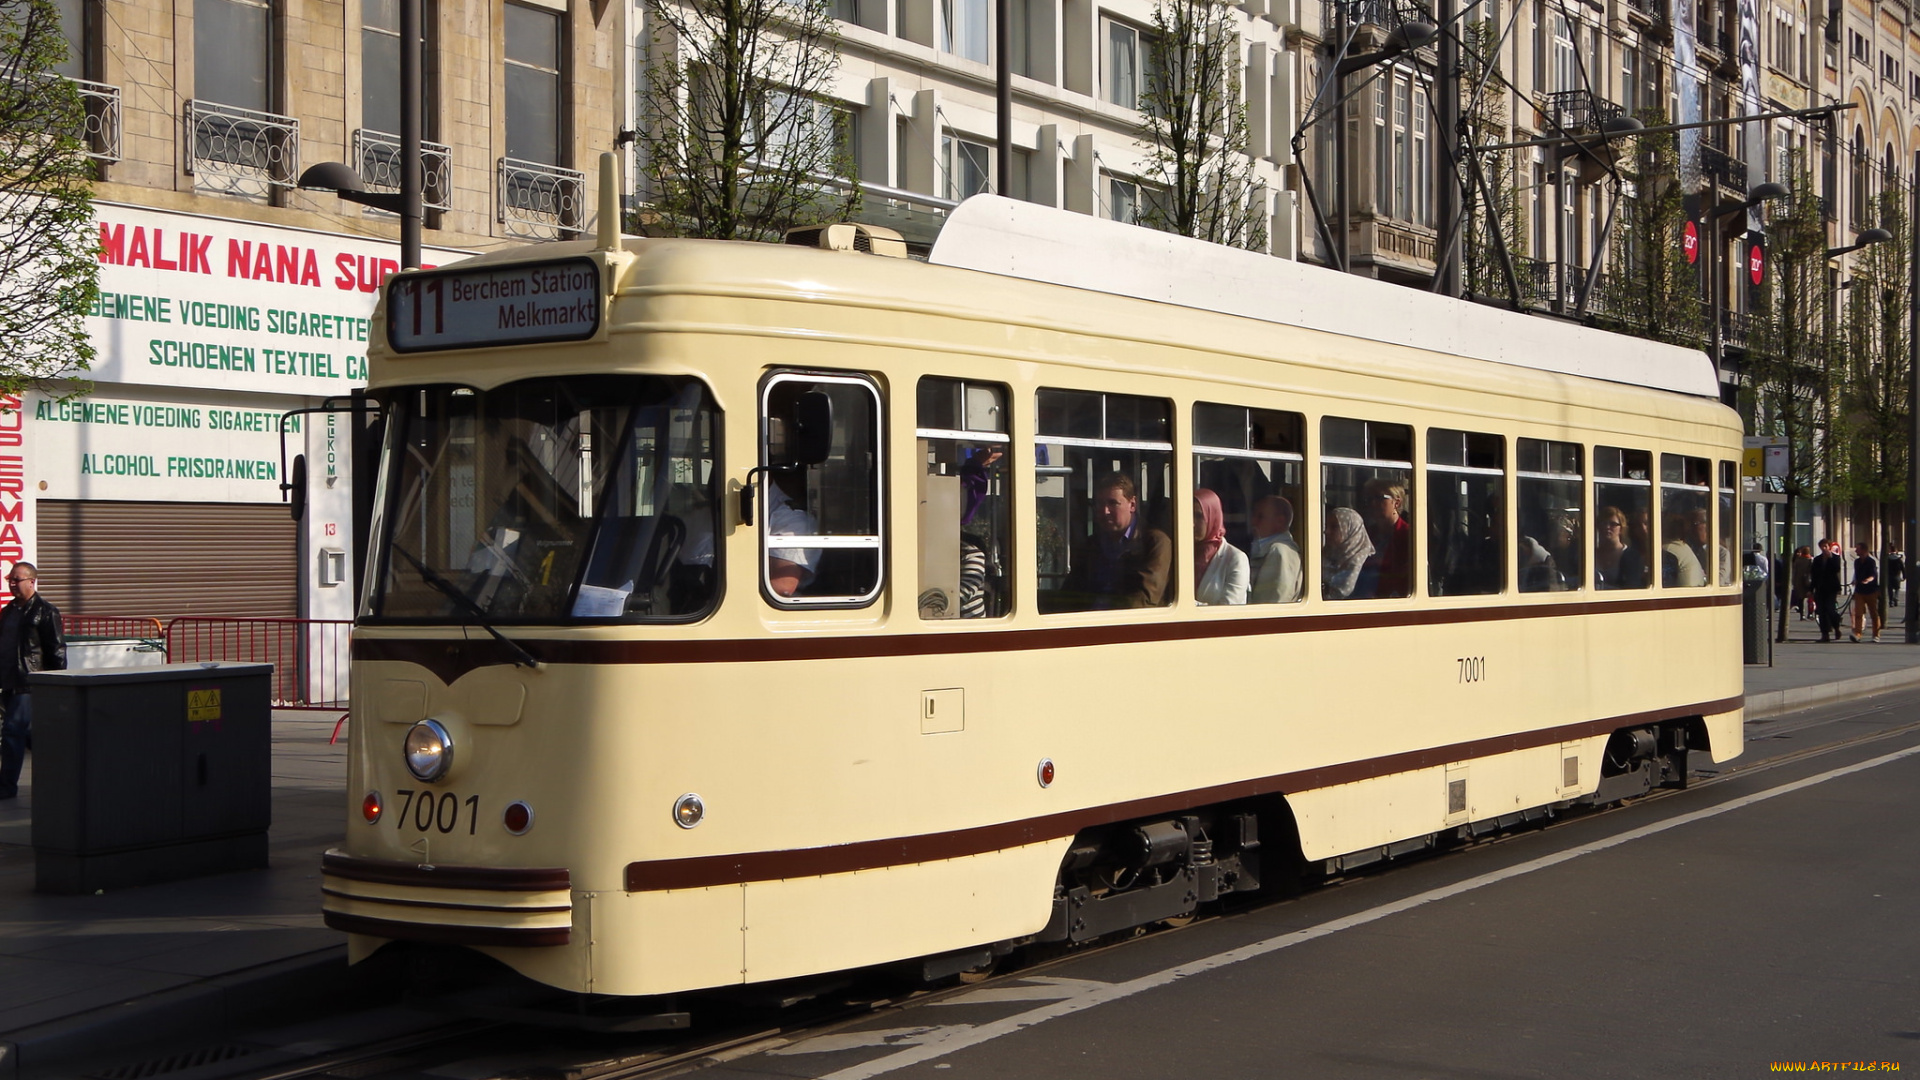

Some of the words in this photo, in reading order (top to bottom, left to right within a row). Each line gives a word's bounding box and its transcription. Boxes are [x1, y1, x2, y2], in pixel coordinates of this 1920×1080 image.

[98, 221, 213, 275] MALIK
[227, 238, 322, 288] NANA
[179, 300, 261, 331] VOEDING
[405, 279, 444, 336] 11
[452, 272, 527, 302] Berchem
[530, 268, 595, 294] Station
[498, 299, 596, 330] Melkmarkt
[148, 339, 256, 373] SCHOENEN
[262, 347, 340, 379] TEXTIEL
[346, 355, 369, 381] CA
[35, 400, 130, 427] ALGEMENE
[132, 404, 201, 430] VOEDING
[207, 409, 301, 434] SIGARETTEN
[81, 453, 160, 478] ALCOHOL
[167, 457, 277, 481] FRISDRANKEN
[324, 523, 336, 537] 13
[540, 550, 555, 585] 1
[1457, 656, 1485, 684] 7001
[397, 789, 479, 835] 7001
